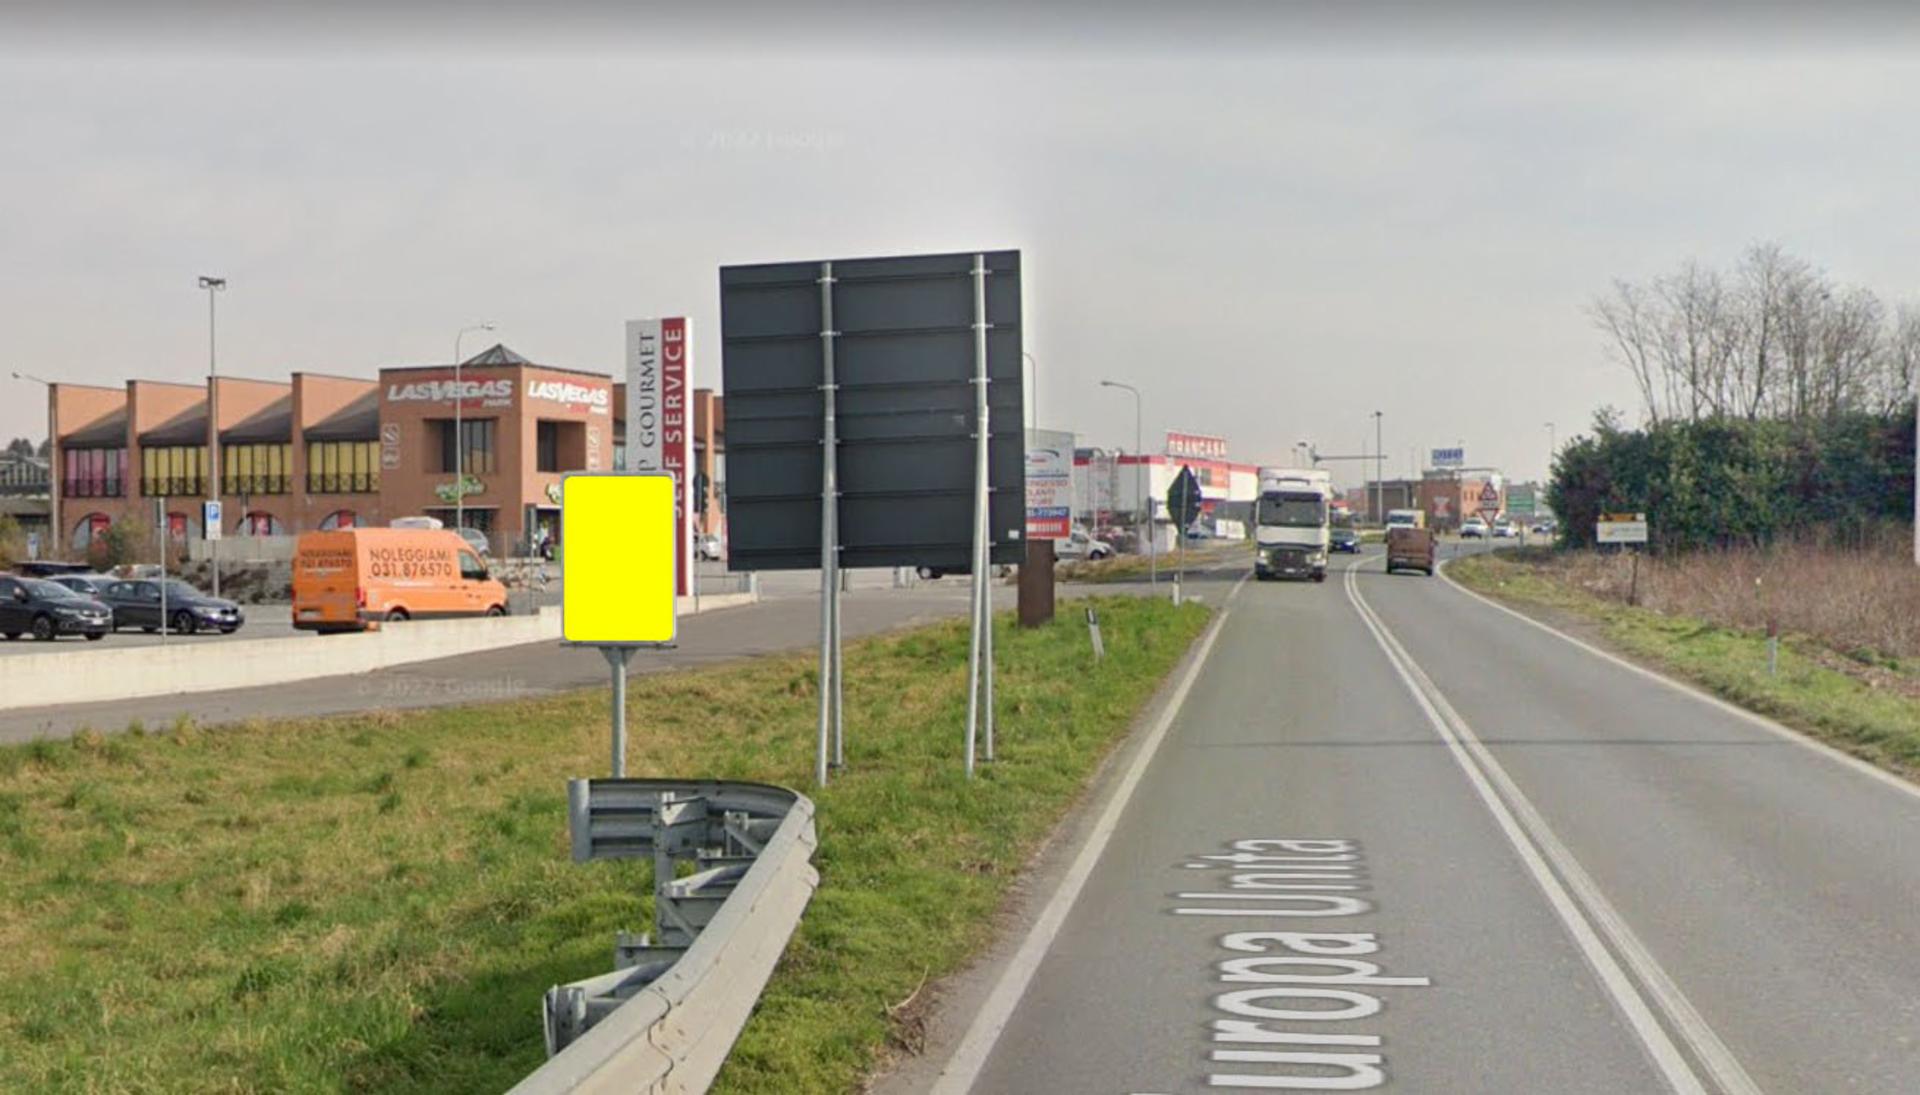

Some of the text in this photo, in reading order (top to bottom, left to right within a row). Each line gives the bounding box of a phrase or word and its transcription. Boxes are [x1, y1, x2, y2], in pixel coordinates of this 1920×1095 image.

[639, 332, 656, 448] GOURMET
[665, 329, 683, 443] SERVICE
[369, 548, 451, 562] NOLEGGIAMI
[371, 562, 453, 577] 031.876570
[1207, 931, 1430, 1095] uropa
